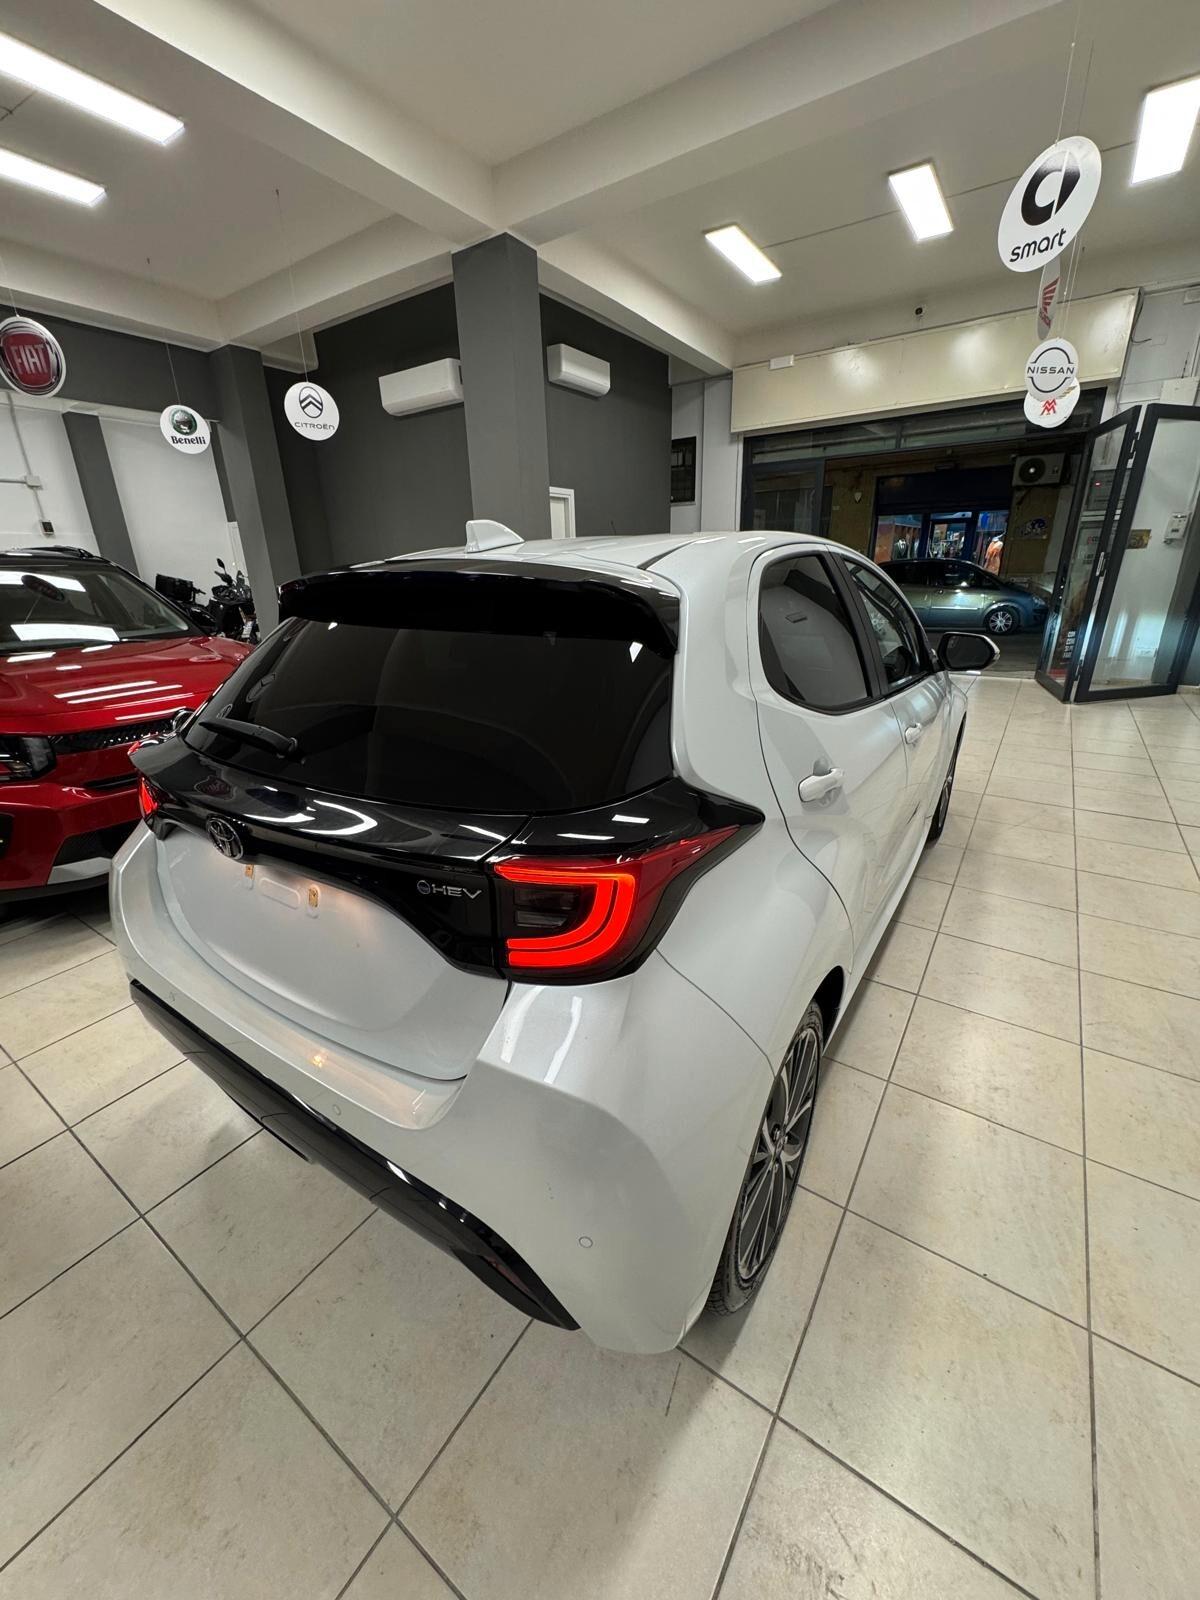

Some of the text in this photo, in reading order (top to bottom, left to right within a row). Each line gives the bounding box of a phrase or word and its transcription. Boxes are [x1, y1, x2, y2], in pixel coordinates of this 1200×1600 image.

[1009, 228, 1067, 262] smart
[10, 344, 48, 374] FIAT
[1027, 366, 1075, 375] NISSAN
[294, 421, 335, 431] CITROËN
[171, 435, 206, 445] Benelli
[431, 883, 482, 899] HEV
